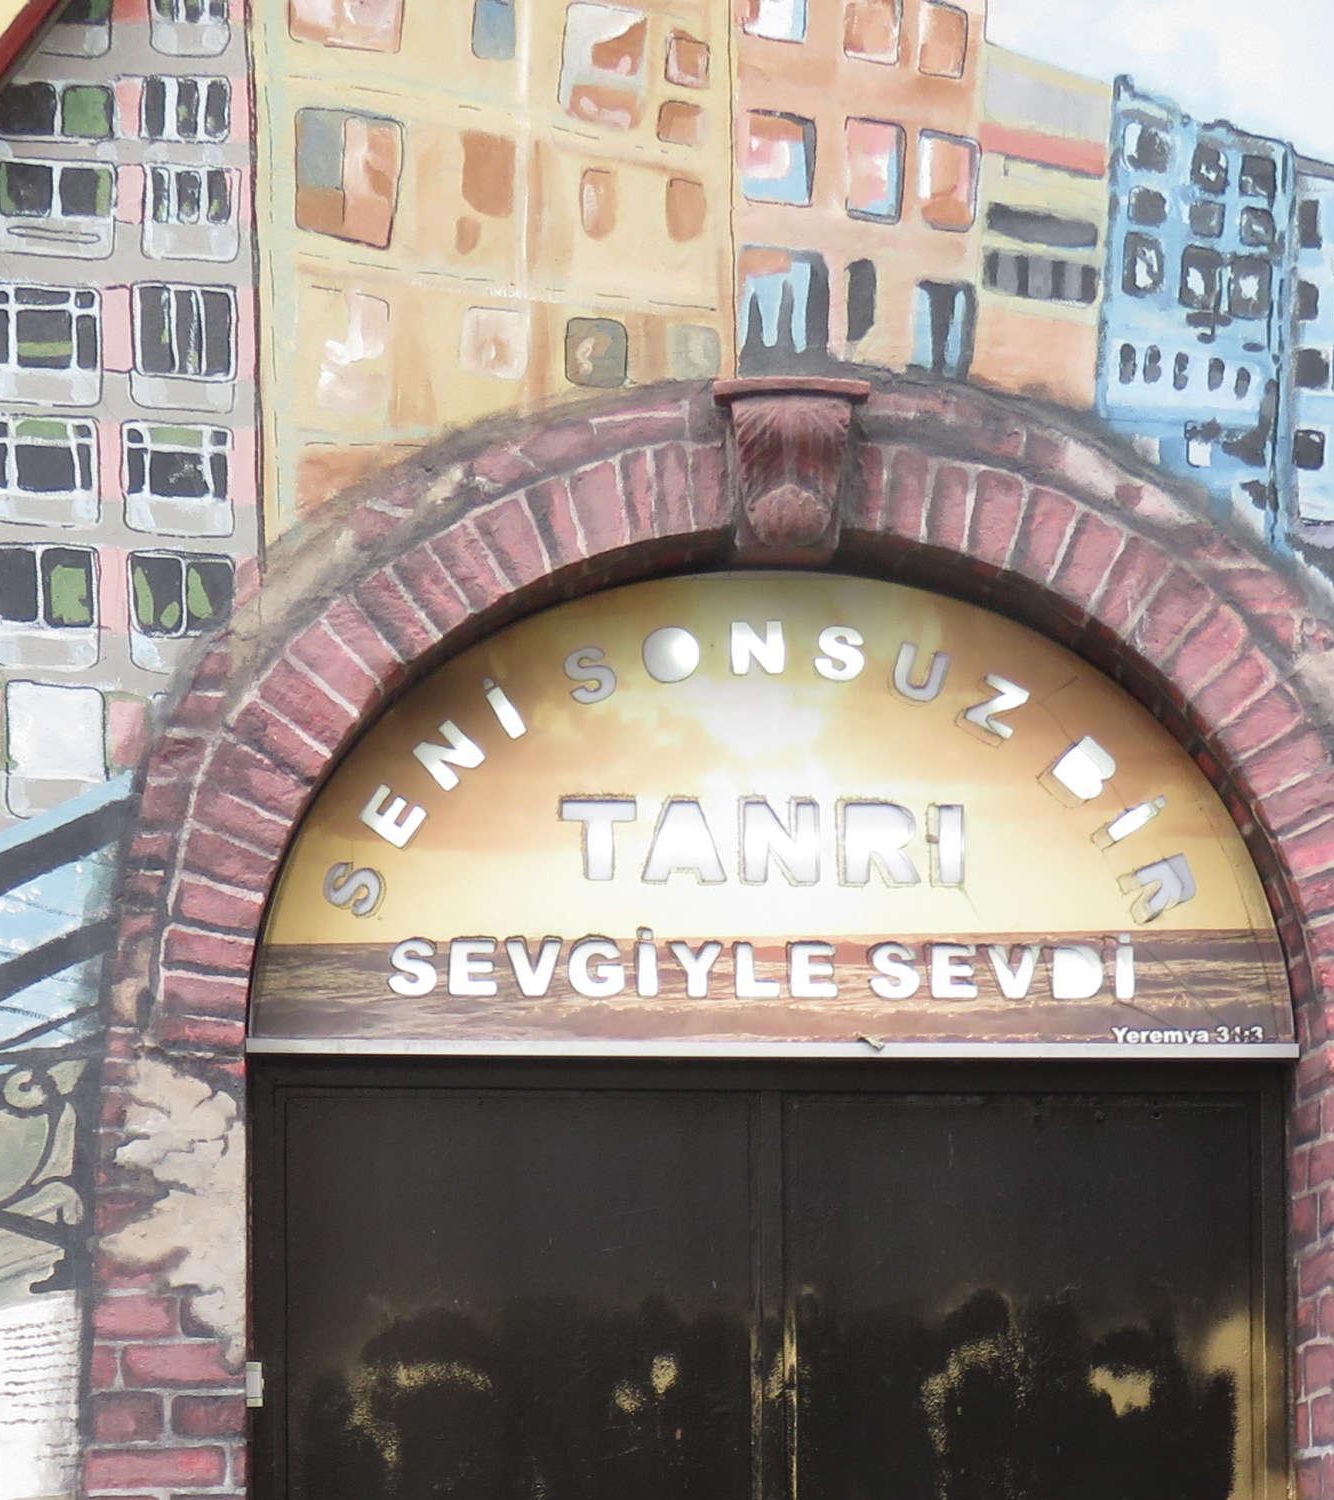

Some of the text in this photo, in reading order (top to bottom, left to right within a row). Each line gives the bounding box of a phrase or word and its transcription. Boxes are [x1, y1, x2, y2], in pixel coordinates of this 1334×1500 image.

[563, 619, 1030, 741] SONSUZ
[558, 795, 966, 886] TANRI
[386, 927, 1136, 1000] SEVGİYLE SEVDİ
[1112, 1025, 1210, 1044] Yeremya
